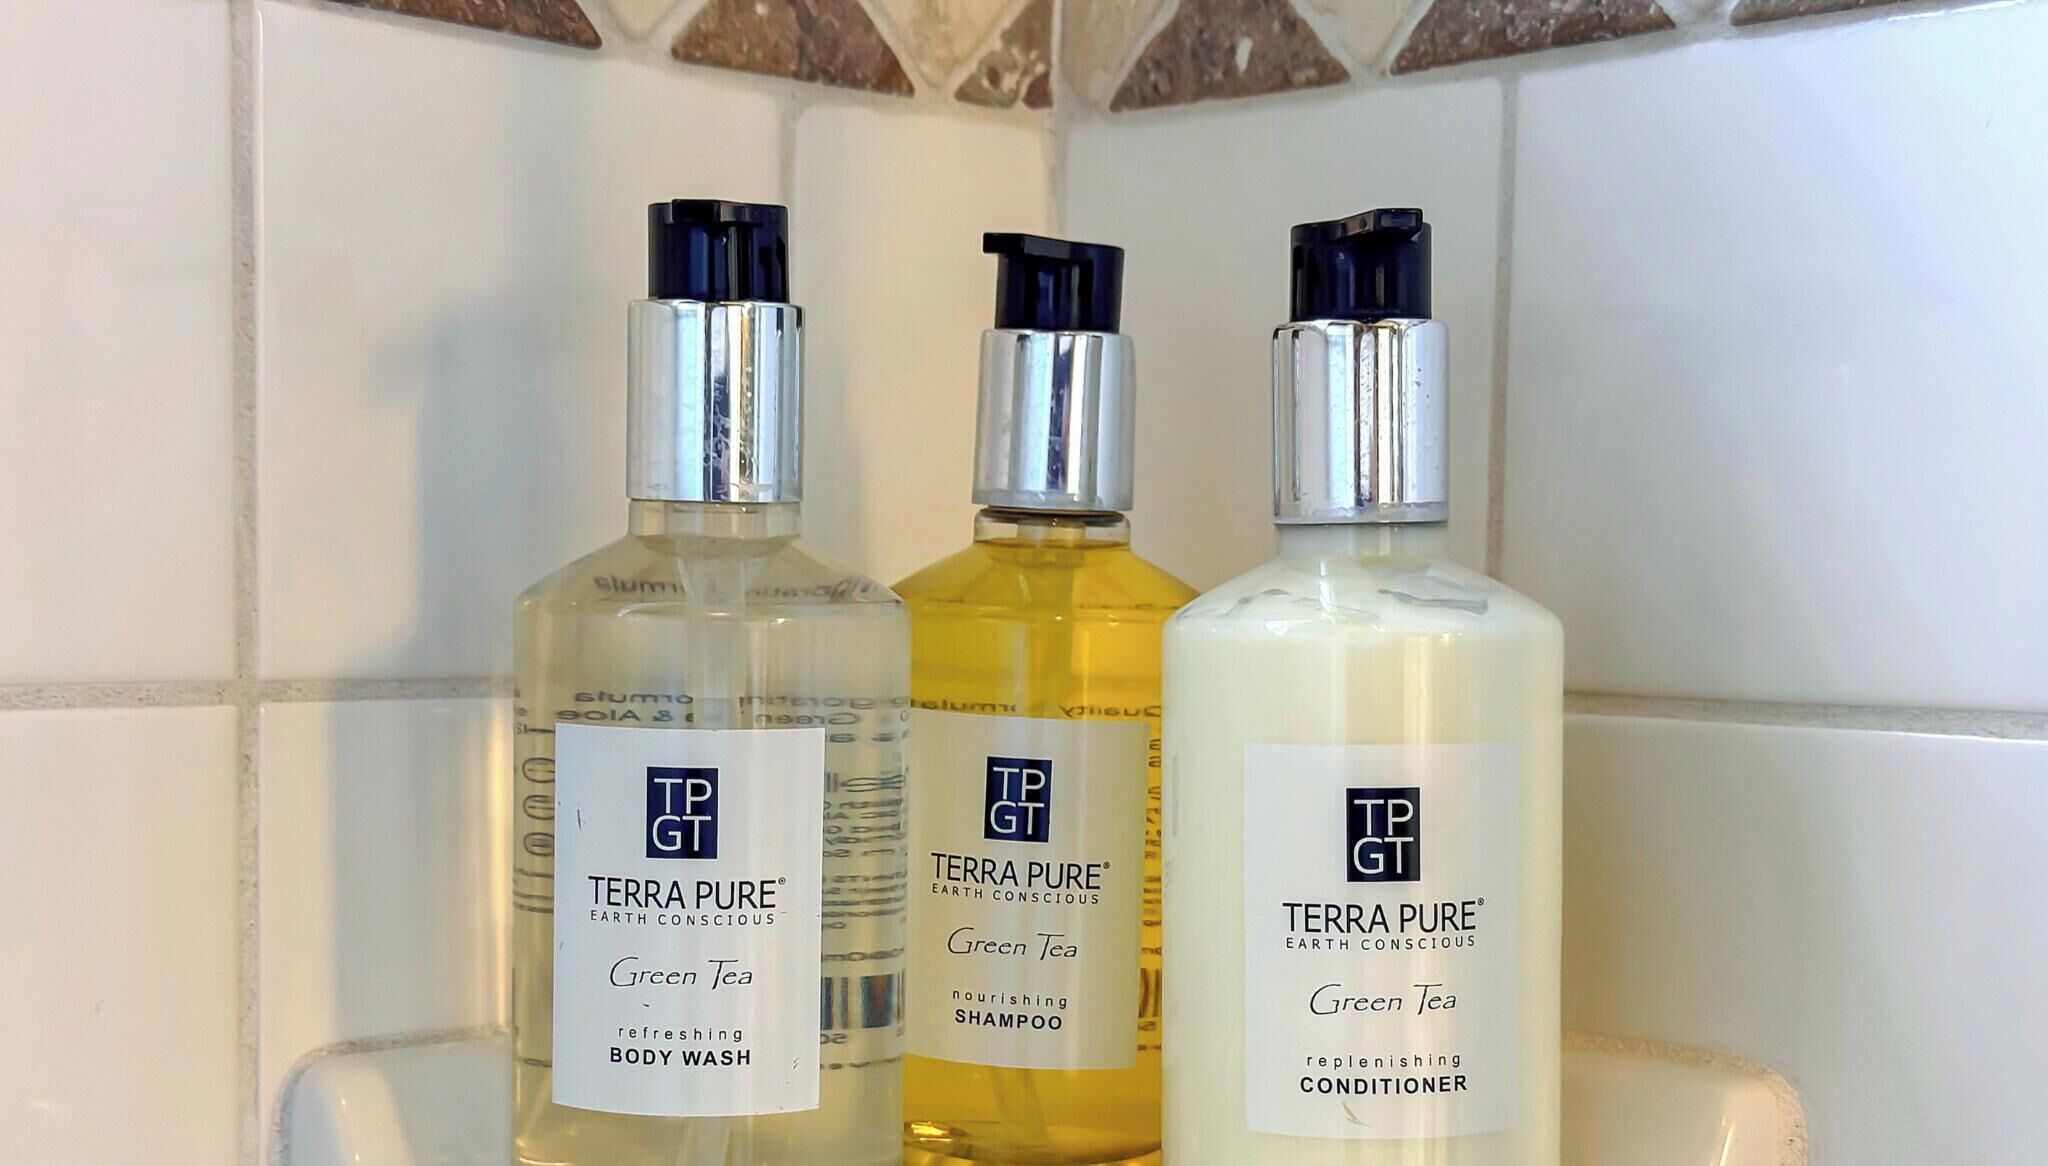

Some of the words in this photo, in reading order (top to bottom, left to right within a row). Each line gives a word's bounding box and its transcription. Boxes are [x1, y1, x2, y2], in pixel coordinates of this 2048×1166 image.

[653, 777, 713, 815] TP
[992, 766, 1046, 802] TP
[651, 815, 712, 852] GT
[990, 801, 1045, 836] GT
[1353, 799, 1415, 836] TP
[931, 852, 1019, 887] TERRA
[1353, 836, 1415, 875] GT
[588, 875, 686, 909] TERRA
[932, 883, 983, 900] EARTH
[992, 890, 1099, 905] CONSCIOUS
[590, 909, 647, 925] EARTH
[657, 913, 775, 927] CONSCIOUS
[1282, 902, 1390, 934] TERRA
[947, 927, 1027, 955] Green
[1036, 932, 1078, 961] Tea
[1286, 937, 1349, 951] EARTH
[1361, 935, 1475, 951] CONSCIOUS
[609, 956, 697, 987] Green
[707, 959, 753, 991] Tea
[952, 990, 1068, 1009] nourishing
[1309, 983, 1403, 1015] Green
[1413, 983, 1457, 1016] Tea
[617, 1026, 743, 1042] refreshing
[954, 1008, 1063, 1031] SHAMPOO
[609, 1047, 673, 1066] BODY
[681, 1050, 751, 1067] WASH
[1306, 1054, 1461, 1070] replenishing
[1300, 1075, 1468, 1096] CONDITIONER
